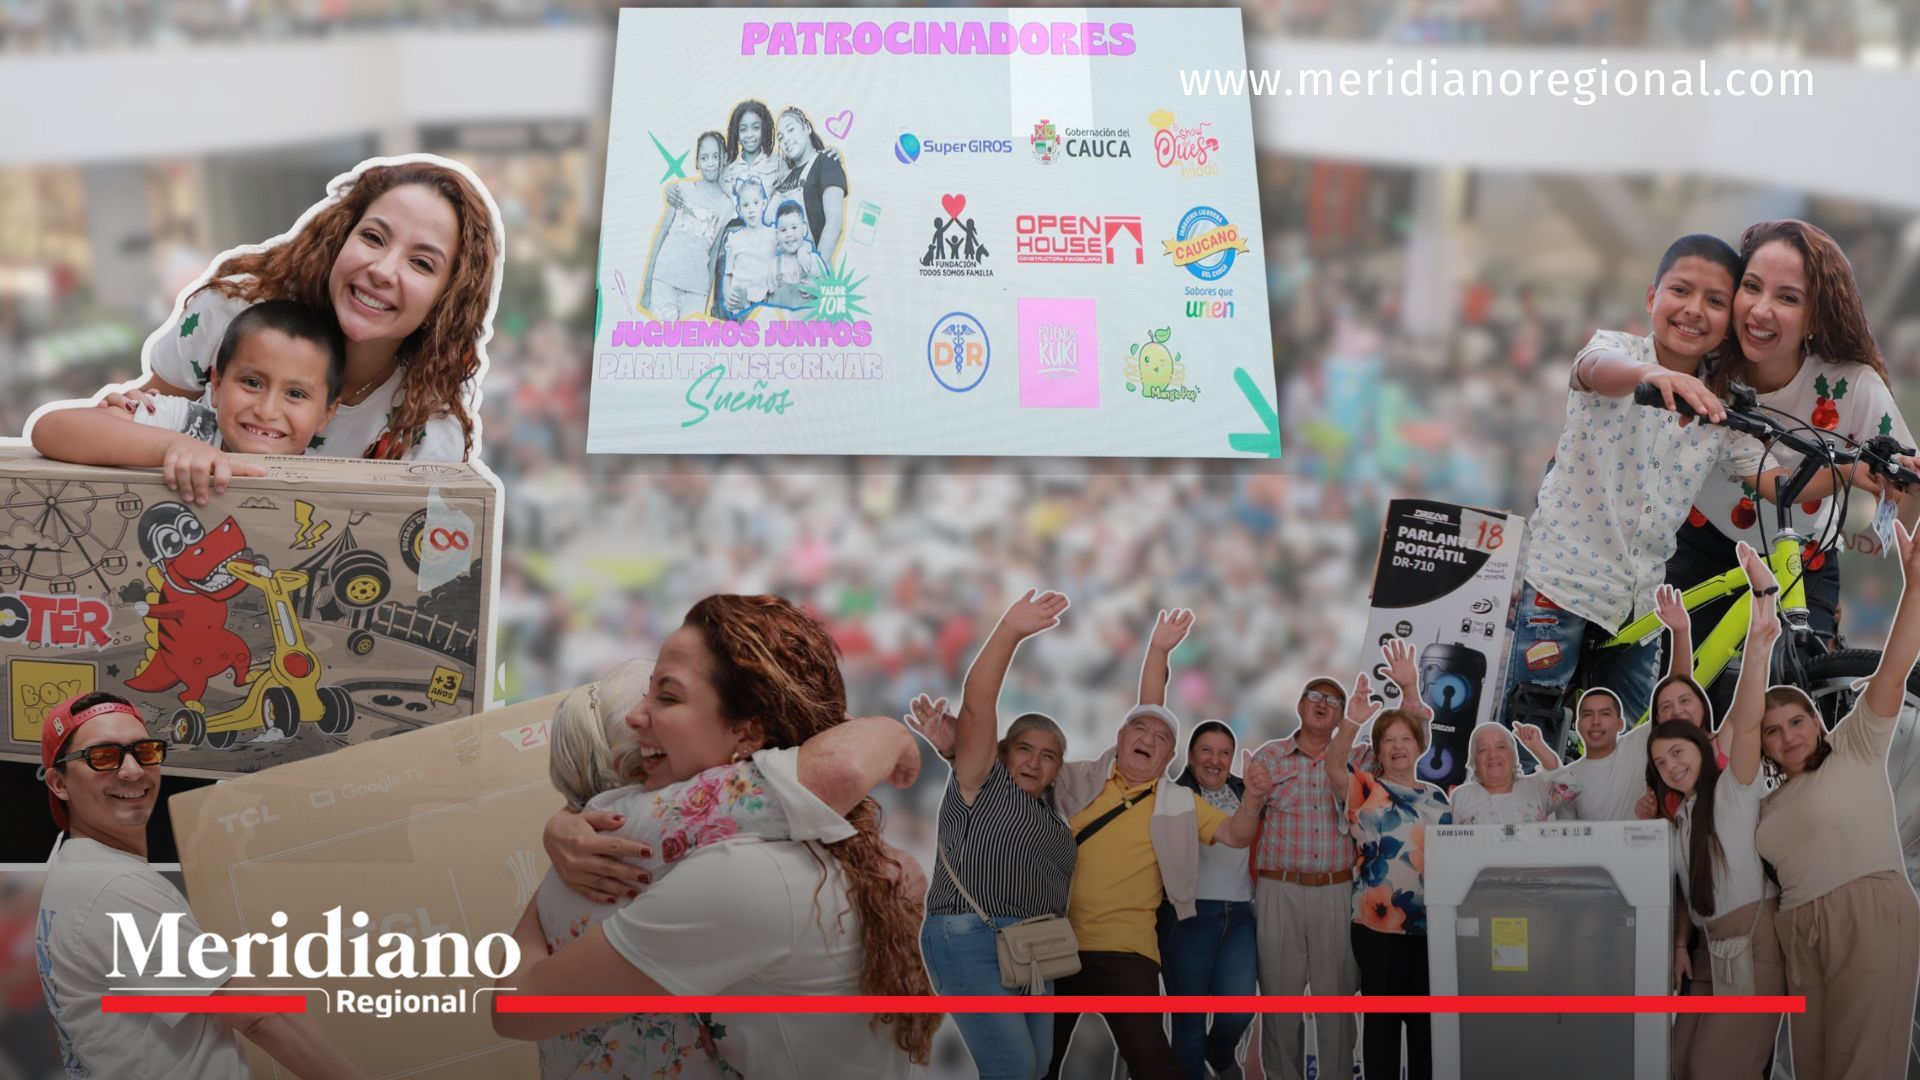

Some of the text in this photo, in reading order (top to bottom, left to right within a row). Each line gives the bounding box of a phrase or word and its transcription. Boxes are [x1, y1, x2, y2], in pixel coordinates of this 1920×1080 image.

[741, 22, 1137, 56] PATROCINADORES
[1065, 127, 1131, 137] Gobernación del
[1065, 139, 1132, 158] CAUCA
[1016, 215, 1101, 235] OPEN
[1017, 236, 1103, 253] HOUSE
[1175, 228, 1237, 260] CAUCANO
[935, 260, 977, 268] FUNDACIÓN
[1184, 286, 1233, 298] Sabores que
[1185, 300, 1235, 318] unen
[611, 320, 873, 347] JUGUEMOS JUNTOS
[598, 353, 884, 381] PARA TRANSFORMAR
[681, 364, 793, 428] Sueños
[1397, 525, 1477, 550] PARLANTE
[1476, 519, 1504, 550] 18
[1395, 540, 1467, 565] PORTÁTIL
[1392, 555, 1436, 573] DR-710
[435, 675, 456, 690] +3
[341, 765, 425, 799] Google TV
[218, 804, 280, 833] TCL
[1436, 829, 1475, 837] SAMSUNG
